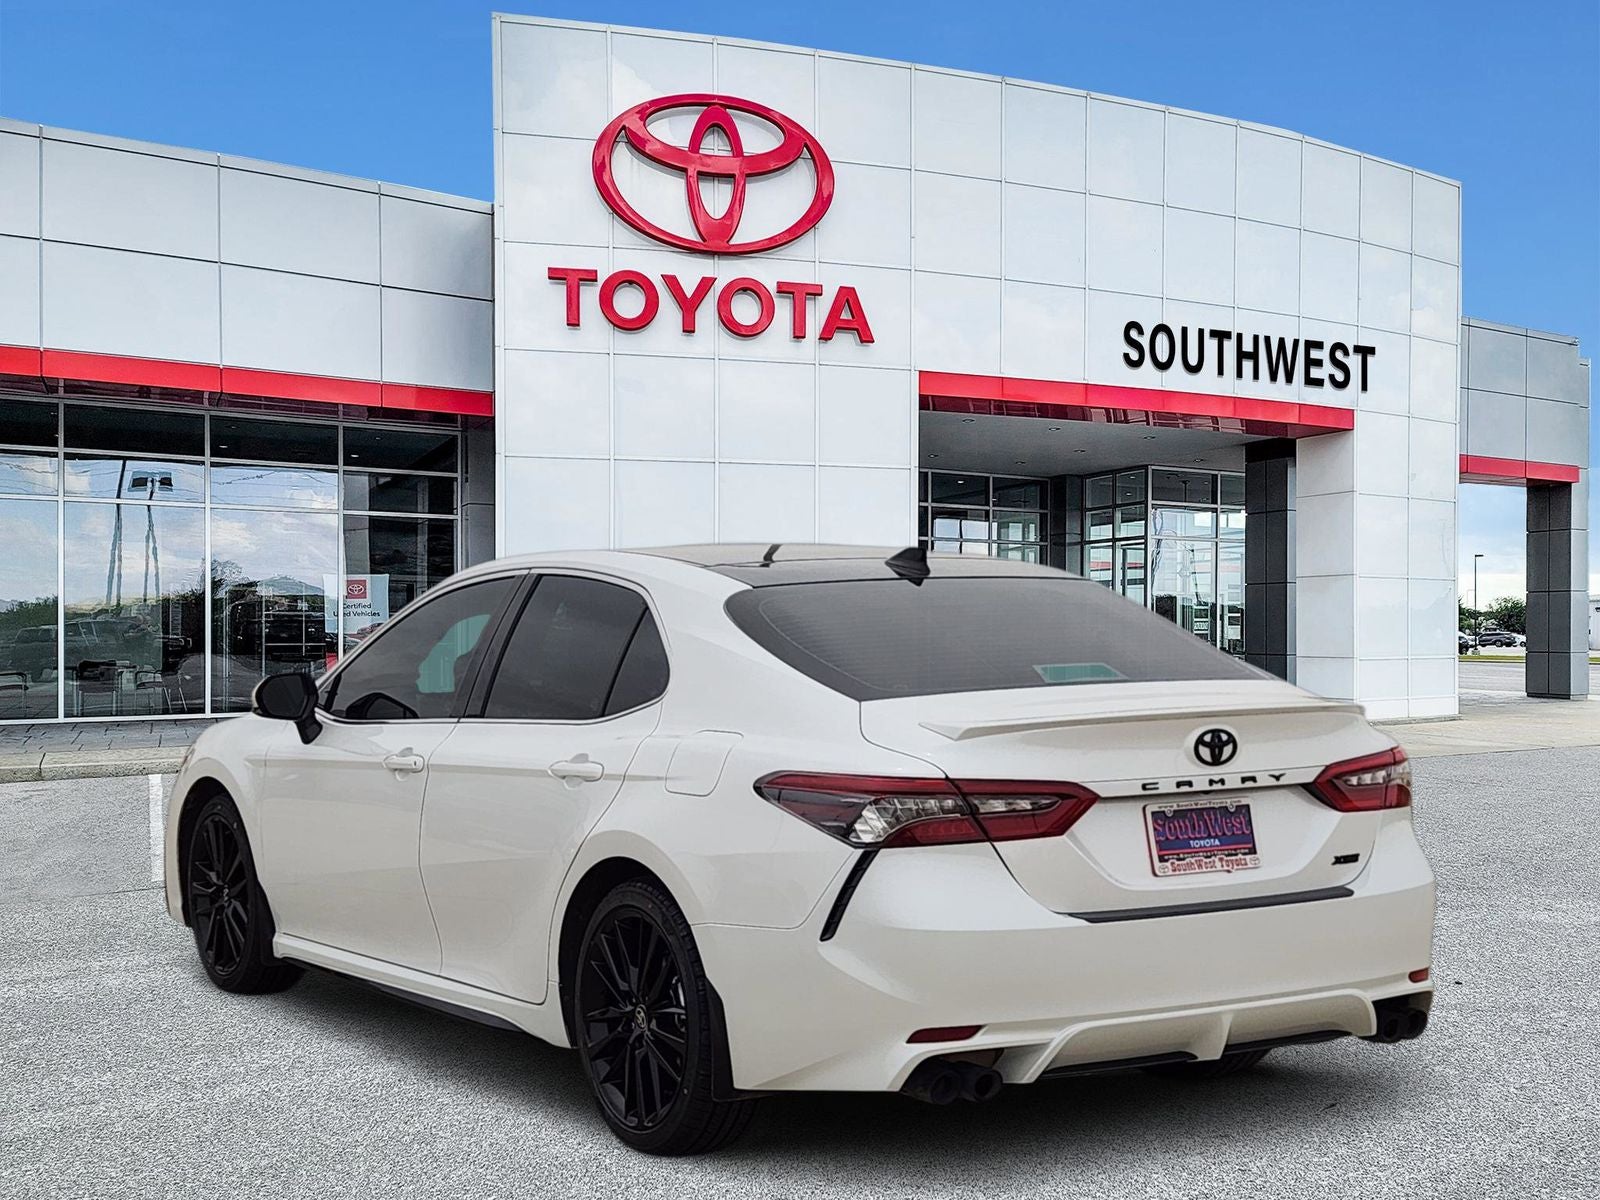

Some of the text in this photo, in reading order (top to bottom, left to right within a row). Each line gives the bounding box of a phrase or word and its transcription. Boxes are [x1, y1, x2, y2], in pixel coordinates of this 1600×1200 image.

[548, 267, 875, 344] TOYOTA
[1122, 320, 1376, 393] SOUTHWEST
[333, 610, 351, 618] Ued
[342, 602, 371, 610] Certified
[1141, 773, 1286, 791] CAMRY
[1189, 839, 1220, 848] TOYOTA
[1170, 856, 1248, 872] SouthWest Toyota
